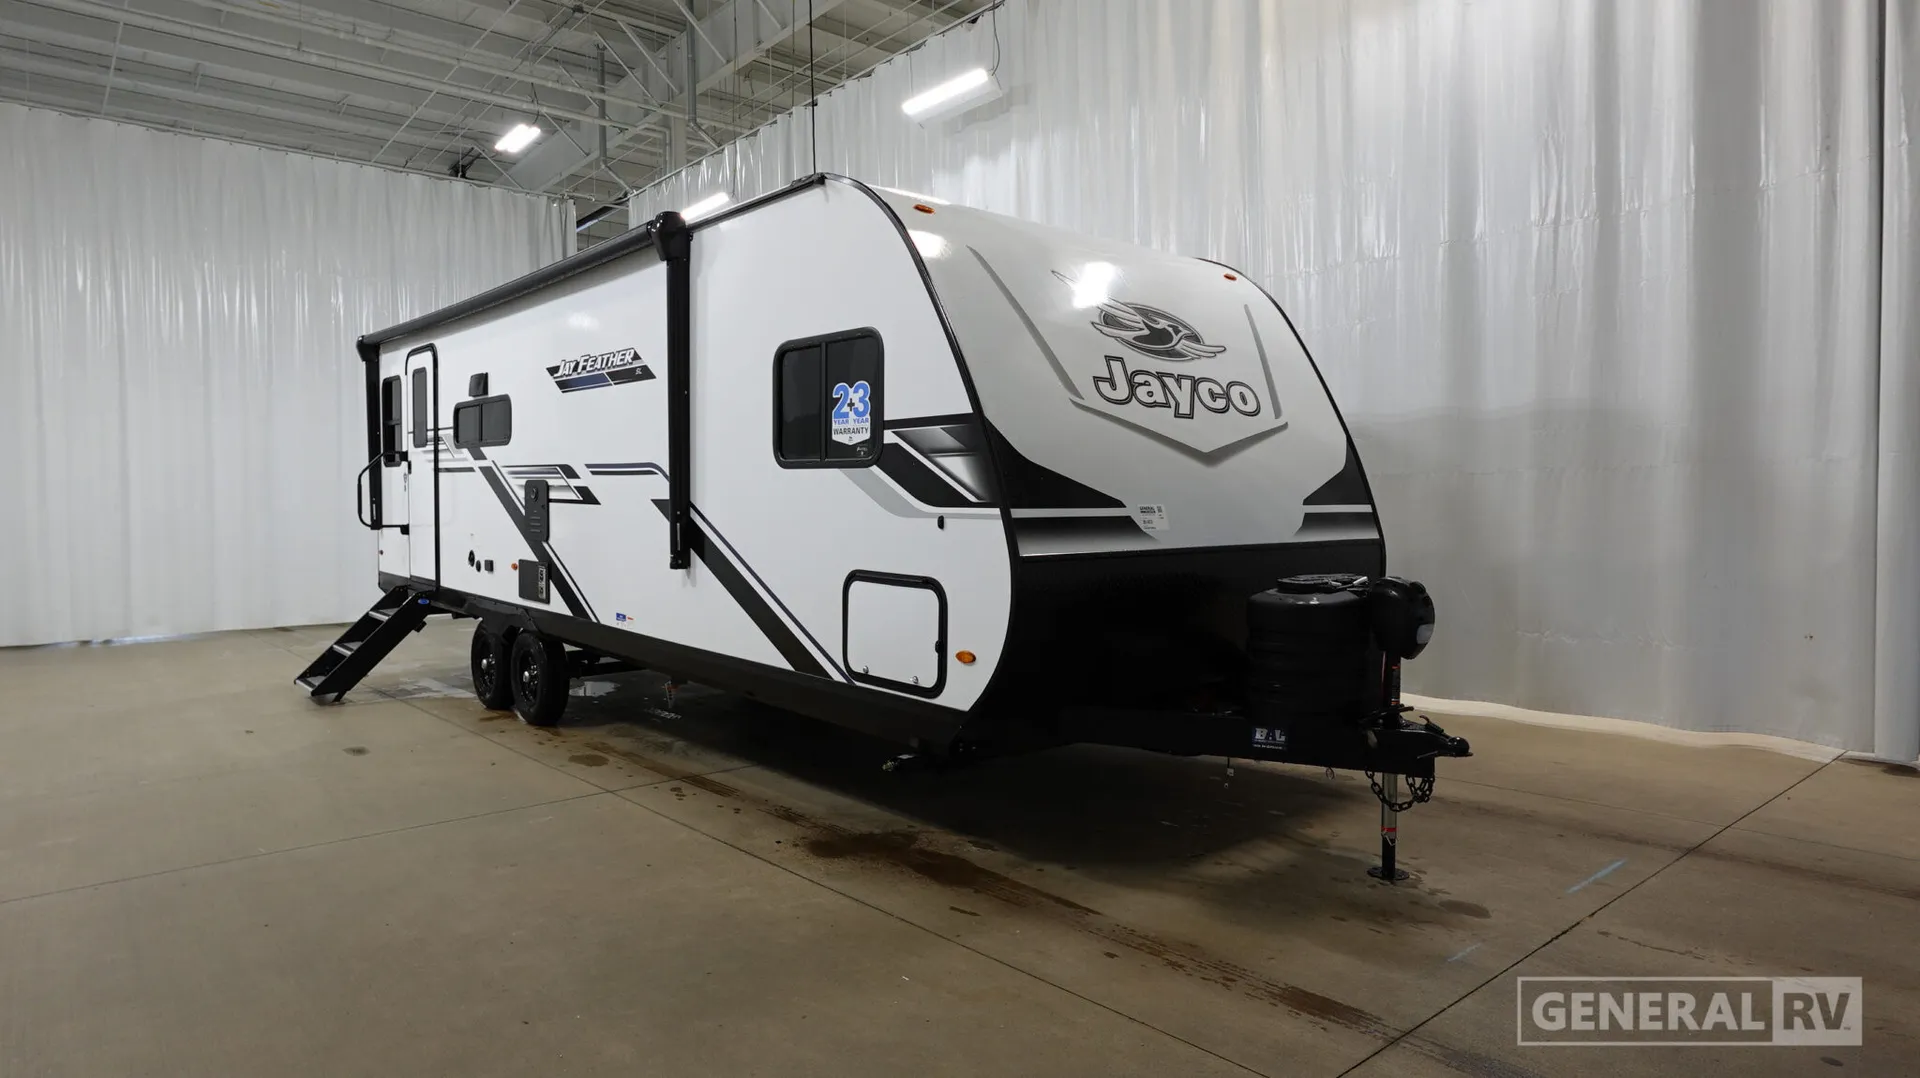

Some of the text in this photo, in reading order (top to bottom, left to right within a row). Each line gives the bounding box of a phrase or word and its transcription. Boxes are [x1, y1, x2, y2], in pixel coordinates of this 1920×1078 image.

[553, 348, 635, 378] JAY FEATHER
[1093, 355, 1261, 419] Jayco
[833, 426, 869, 435] WARRANTY
